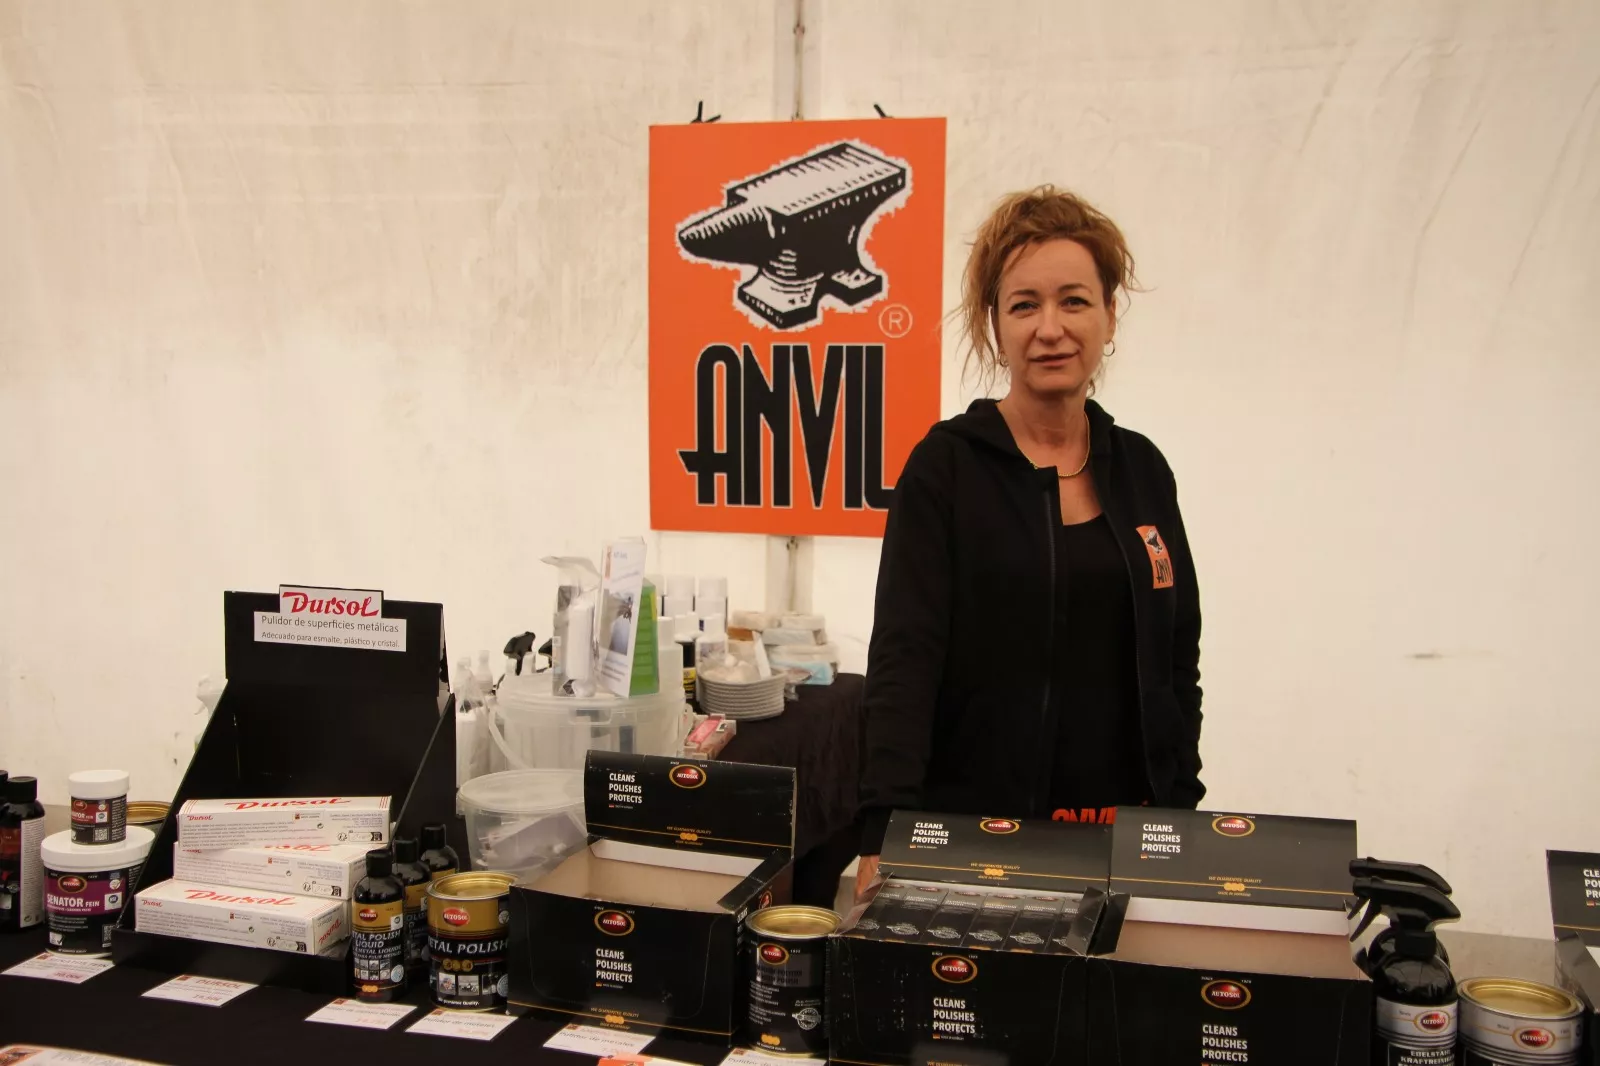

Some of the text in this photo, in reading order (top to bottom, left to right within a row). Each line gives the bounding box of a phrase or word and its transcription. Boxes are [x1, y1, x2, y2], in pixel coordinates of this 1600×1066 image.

[676, 341, 894, 511] ANVIL
[282, 591, 379, 617] Dursol
[261, 616, 399, 633] Pulidor de superficies metálicas
[261, 631, 295, 641] Adecuado
[296, 634, 312, 642] para
[313, 634, 343, 644] esmalte,
[344, 637, 371, 647] plástico
[609, 772, 636, 783] CLEANS
[608, 783, 642, 794] POLISHES
[224, 797, 352, 811] Dursol
[608, 793, 643, 804] PROTECTS
[915, 822, 943, 830] CLEANS
[1143, 824, 1173, 833] CLEANS
[913, 829, 949, 837] POLISHES
[1142, 834, 1181, 843] POLISHES
[911, 836, 948, 845] PROTECTS
[1141, 843, 1181, 853] PROTECTS
[1583, 869, 1600, 878] CLE
[47, 893, 84, 907] SENATOR
[184, 889, 296, 905] Dursol
[369, 930, 401, 941] POLISH
[355, 940, 384, 949] LIQUID
[429, 938, 508, 954] ETAL POLISH
[596, 948, 624, 960] CLEANS
[596, 959, 632, 972] POLISHES
[596, 970, 633, 983] PROTECTS
[1211, 990, 1240, 998] AUTOSOL
[933, 998, 966, 1009] CLEANS
[933, 1010, 975, 1022] POLISHES
[1422, 1017, 1446, 1025] AUTOSOL
[933, 1022, 976, 1034] PROTECTS
[1202, 1025, 1238, 1037] CLEANS
[1202, 1037, 1248, 1050] POLISHES
[1521, 1034, 1549, 1043] AUTOSOL
[1202, 1049, 1248, 1062] PROTECTS
